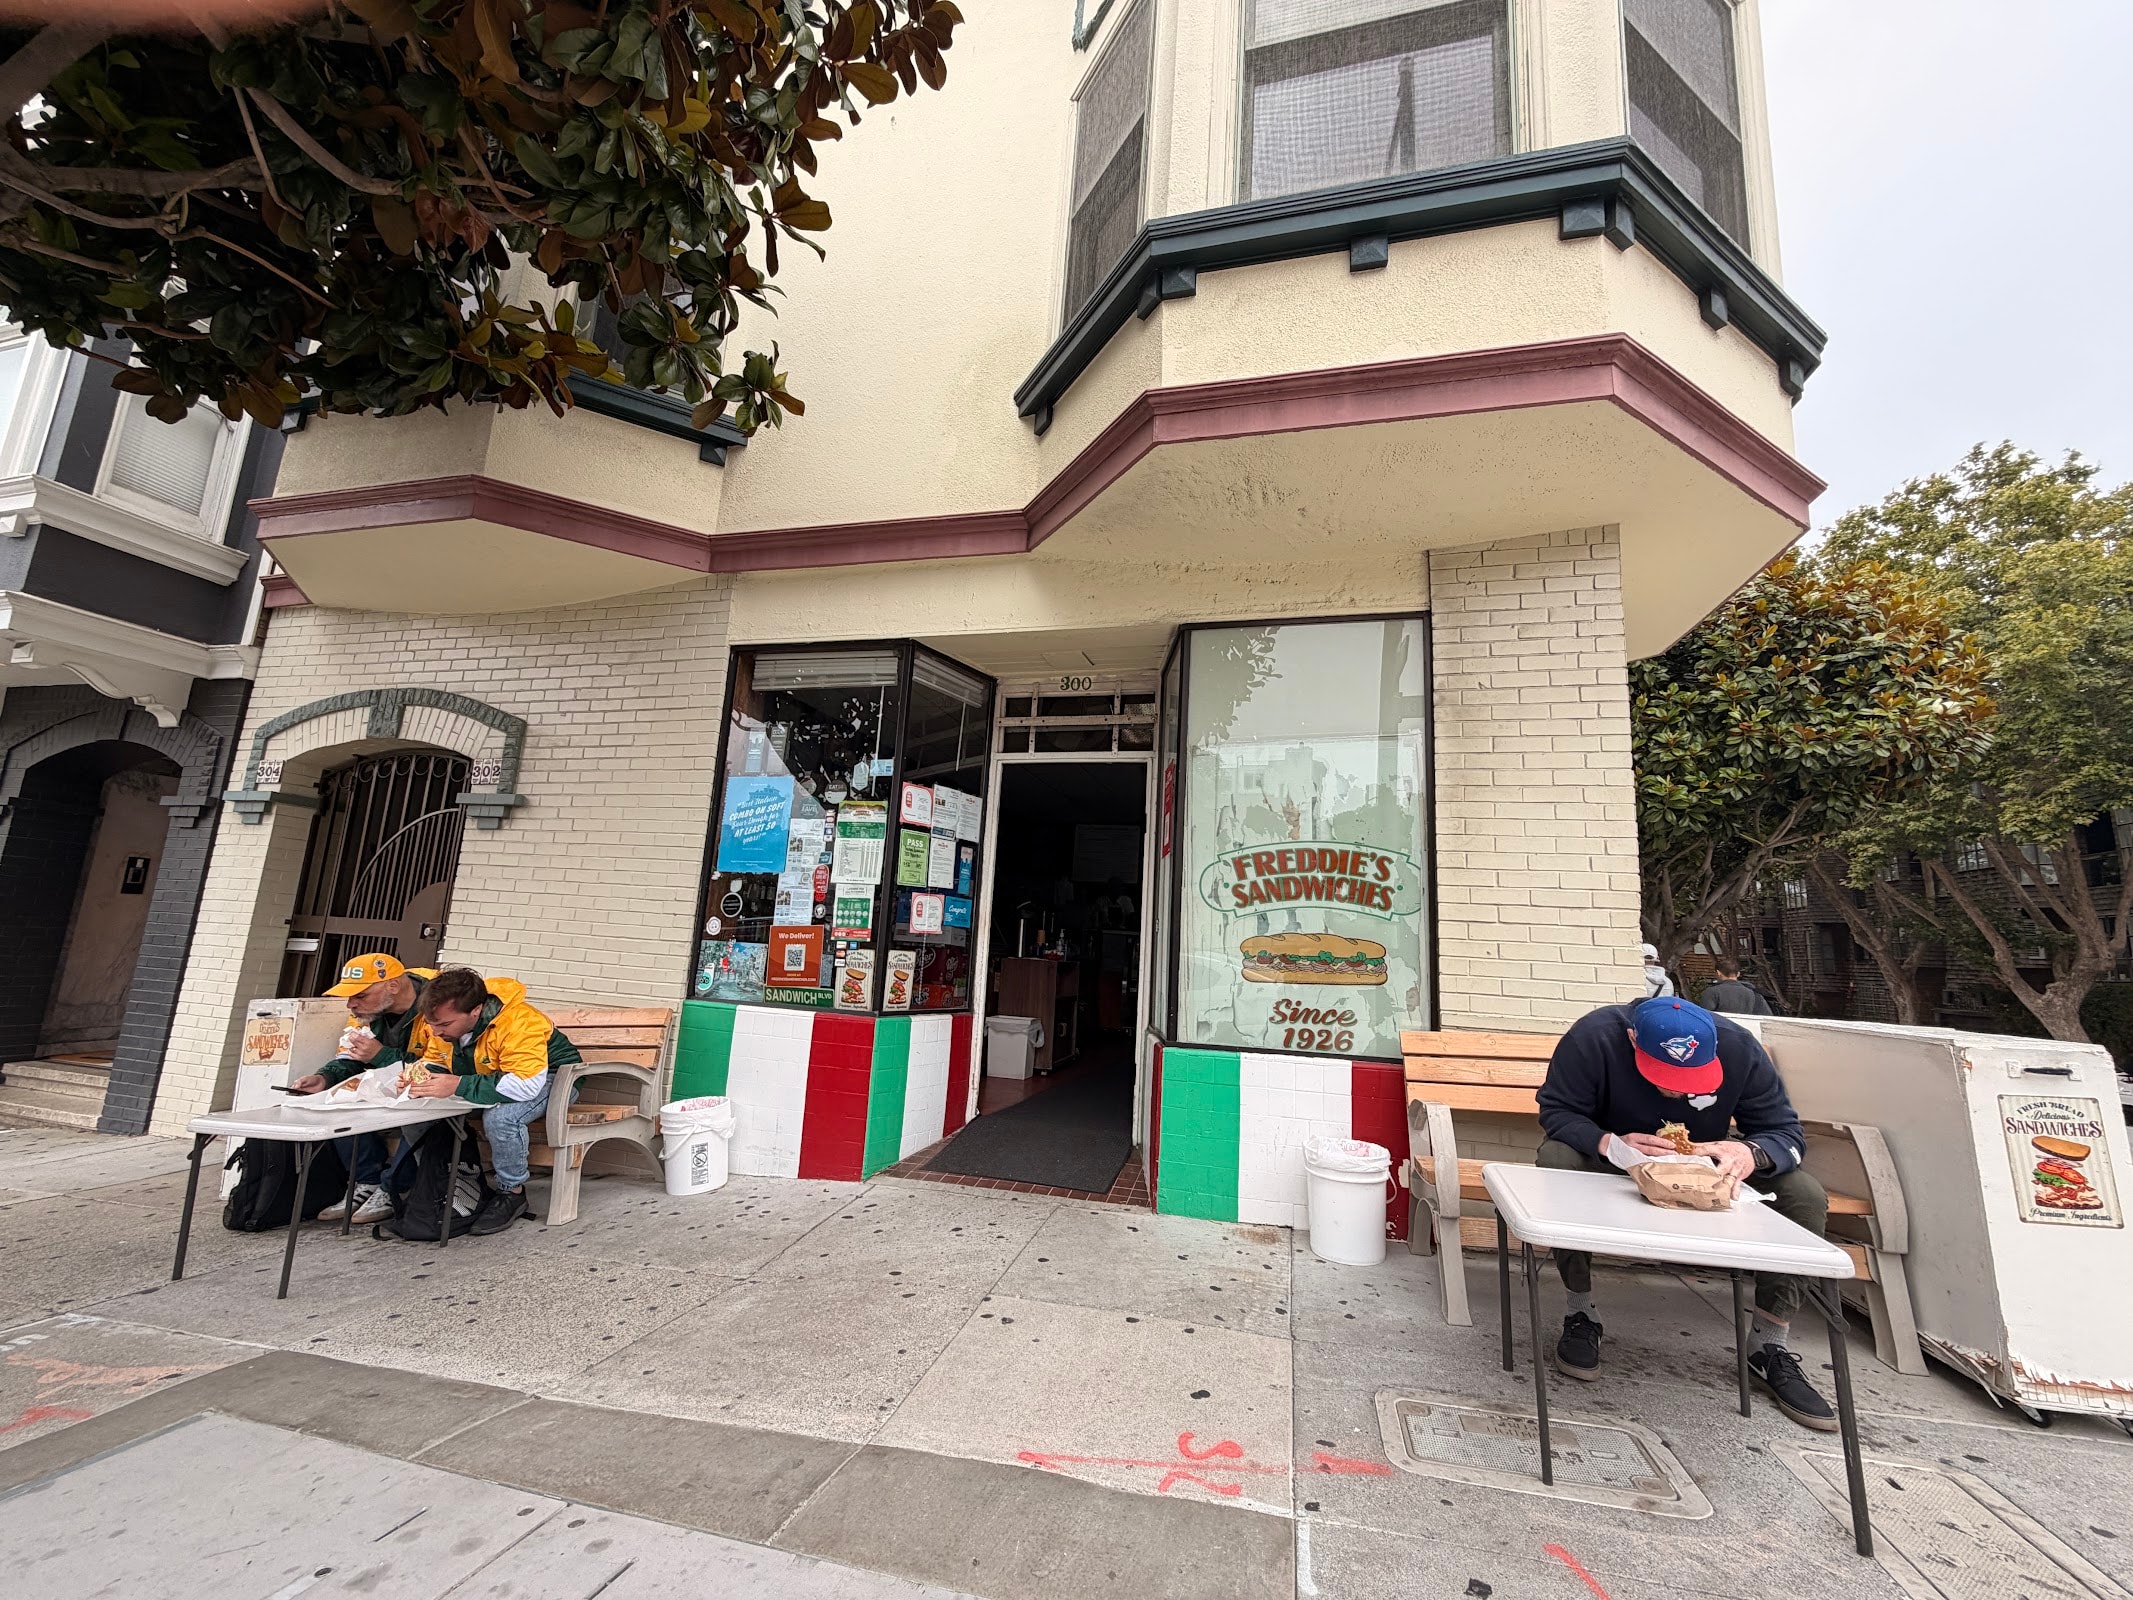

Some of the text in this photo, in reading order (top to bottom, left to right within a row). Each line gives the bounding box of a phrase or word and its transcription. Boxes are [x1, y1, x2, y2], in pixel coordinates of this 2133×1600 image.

[1060, 676, 1092, 691] 300
[256, 766, 281, 777] 304
[472, 765, 501, 777] 302
[729, 801, 786, 821] COMBO ON SOFT
[734, 821, 777, 838] AT LEAST 50
[907, 838, 924, 848] PASS
[1231, 847, 1395, 882] FREDDIE'S
[1231, 874, 1396, 912] SANDWICHES
[766, 988, 833, 1005] SANDWICH BLVD
[1268, 998, 1358, 1028] Since
[1282, 1027, 1355, 1052] 1926
[2016, 1101, 2085, 1118] FRESH BREAD
[2030, 1110, 2071, 1121] Delicious
[2005, 1117, 2102, 1138] SANDWICHES
[2029, 1207, 2113, 1221] Premium Ingredients
